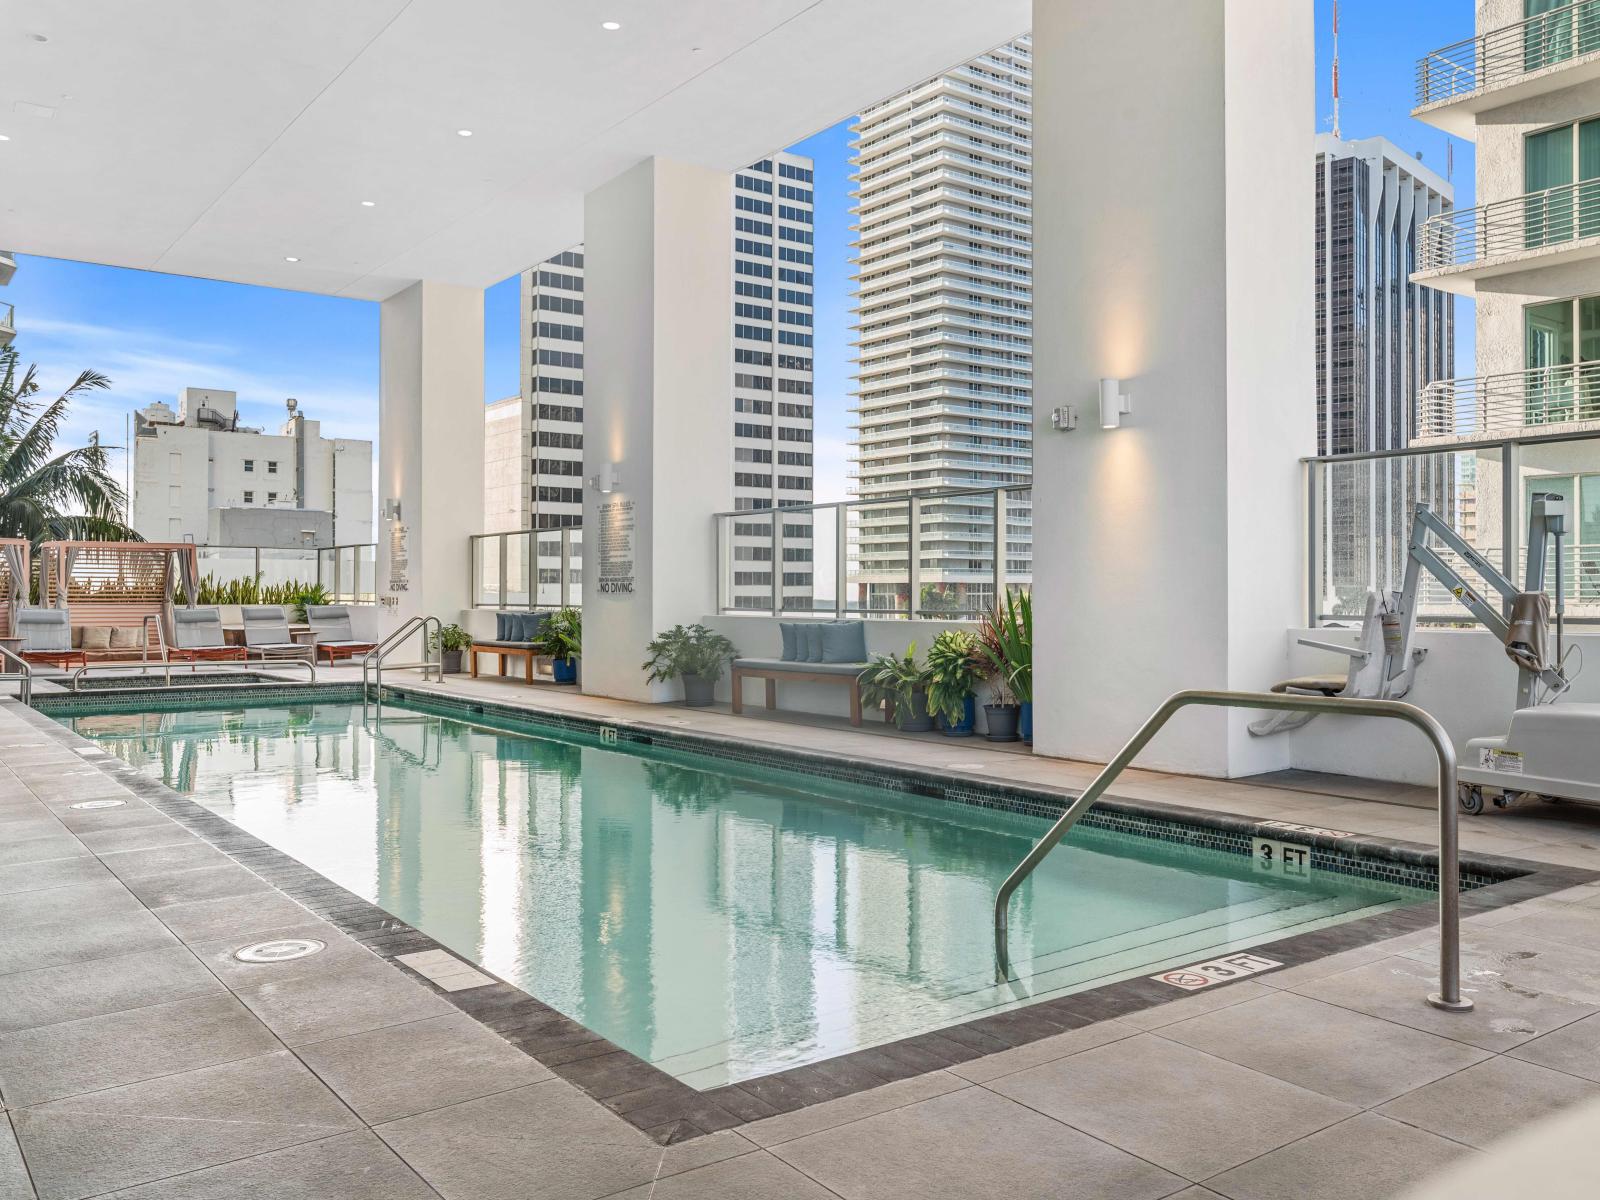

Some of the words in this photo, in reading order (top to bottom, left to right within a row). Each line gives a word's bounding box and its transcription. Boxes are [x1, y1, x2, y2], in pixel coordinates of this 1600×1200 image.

[600, 582, 609, 593] NO
[610, 582, 633, 593] DIVING
[608, 730, 616, 738] FT
[1260, 843, 1273, 860] 3
[1283, 846, 1307, 866] FT
[1201, 965, 1237, 976] 3
[1223, 955, 1272, 970] FT
